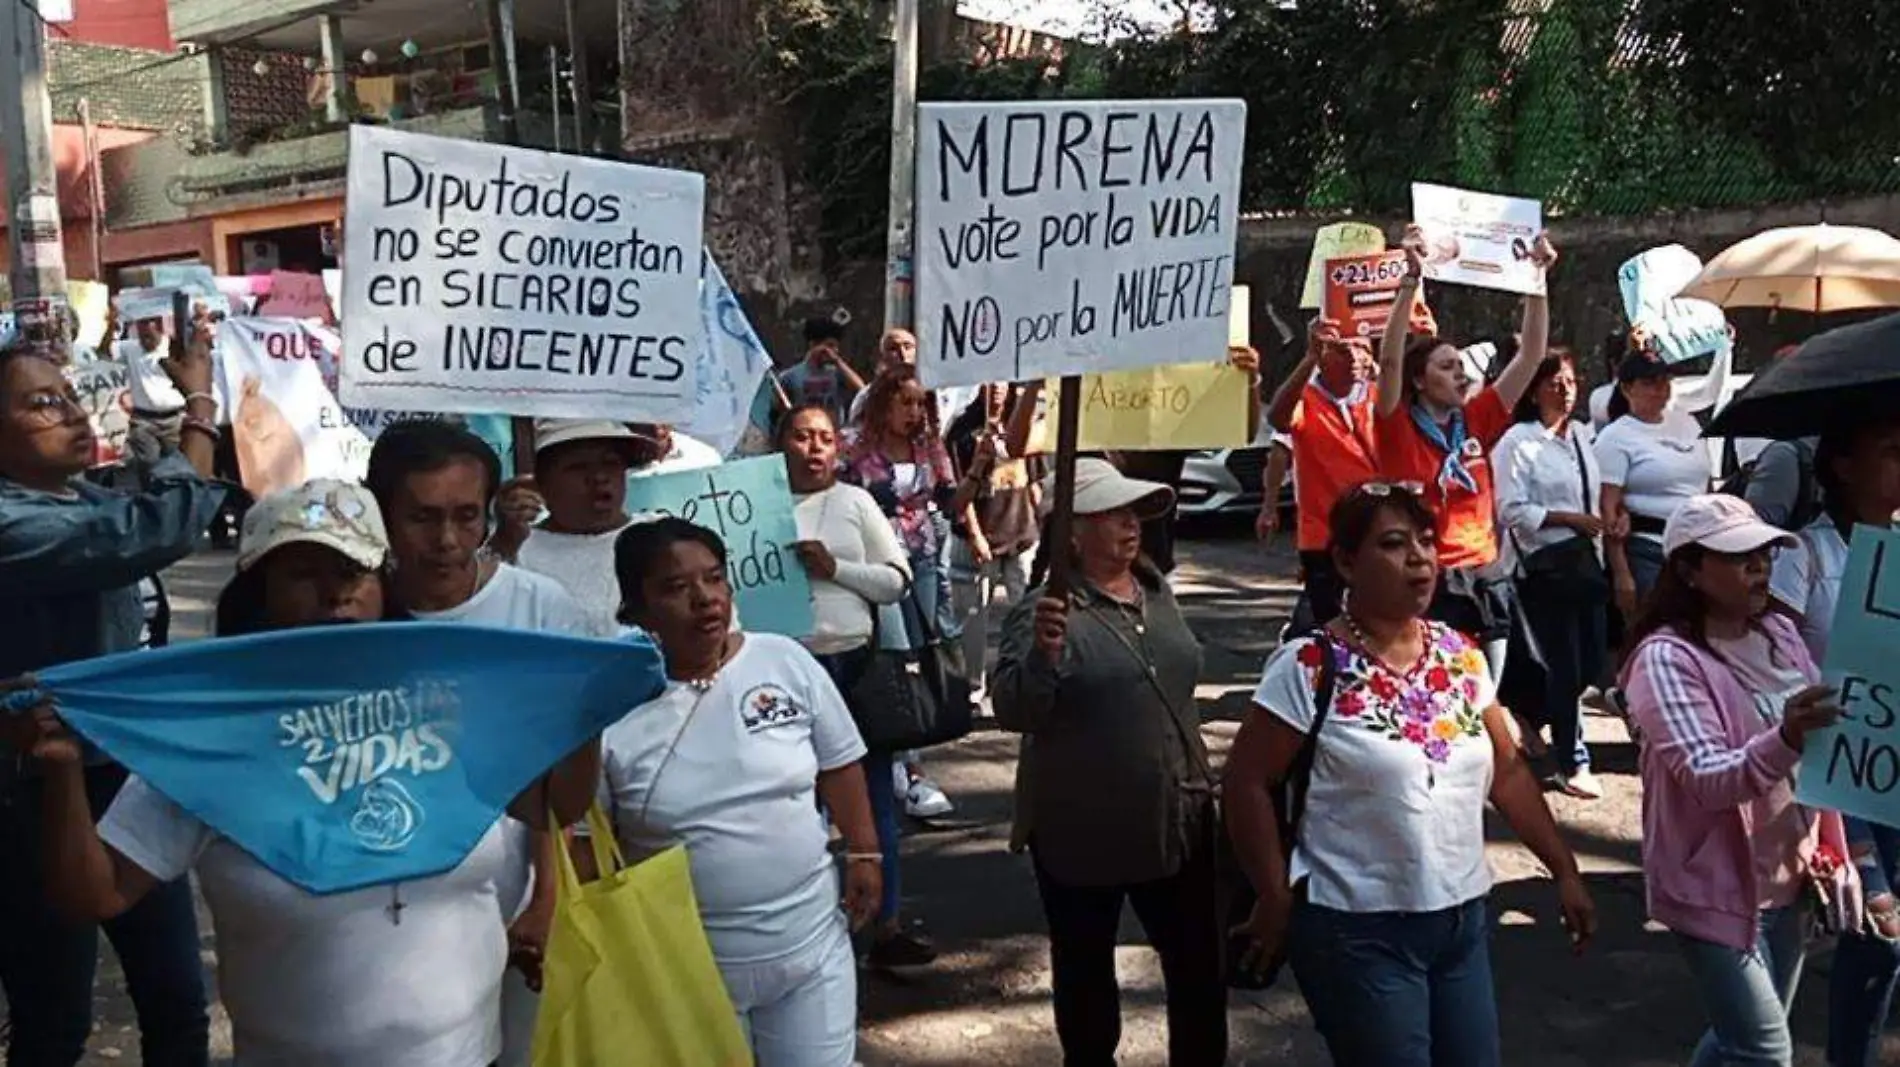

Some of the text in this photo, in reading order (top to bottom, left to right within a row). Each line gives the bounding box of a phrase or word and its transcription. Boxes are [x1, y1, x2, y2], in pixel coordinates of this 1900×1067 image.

[938, 110, 1215, 202] MORENA
[382, 151, 620, 223] Diputados
[373, 227, 419, 262] no
[434, 227, 481, 260] se
[938, 192, 1221, 271] vote por la VIDA
[368, 268, 641, 319] en SICARIOS
[1333, 261, 1409, 284] +21,60
[940, 254, 1233, 379] NO por la MUERTE
[363, 323, 687, 382] de INOCENTES
[278, 686, 411, 747] SALVEMOS
[296, 721, 453, 804] VIDAS
[302, 737, 333, 763] 2
